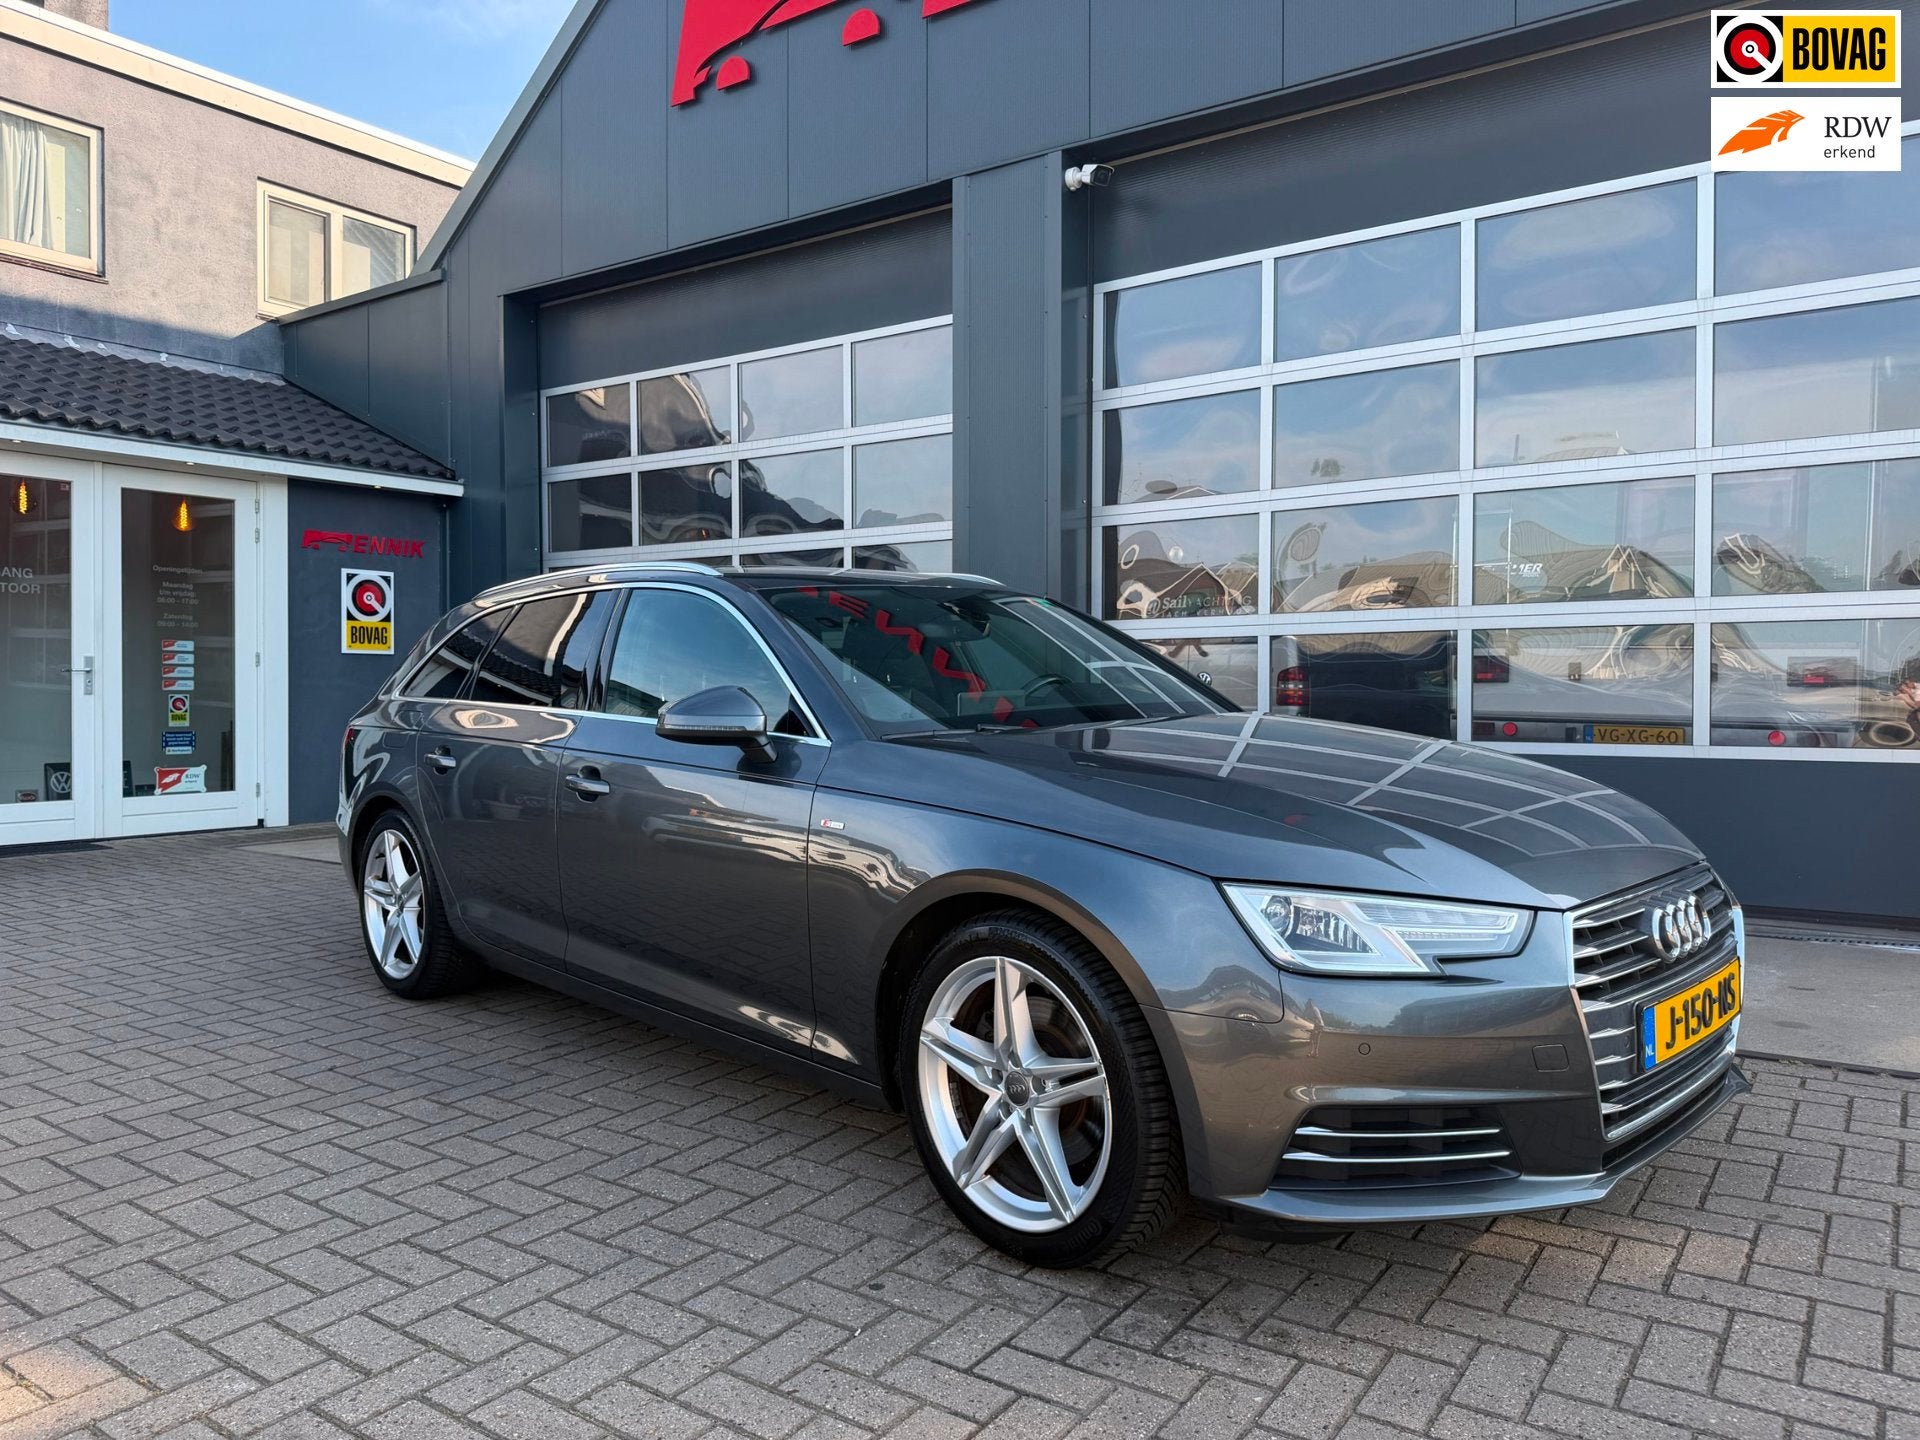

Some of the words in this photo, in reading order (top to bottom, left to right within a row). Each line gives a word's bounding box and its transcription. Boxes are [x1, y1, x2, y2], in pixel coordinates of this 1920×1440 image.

[1, 566, 33, 578] ANG
[0, 582, 40, 594] TOOR
[350, 625, 388, 645] BOVAG
[1598, 728, 1678, 744] VG-XG-60
[1645, 1045, 1655, 1058] NL
